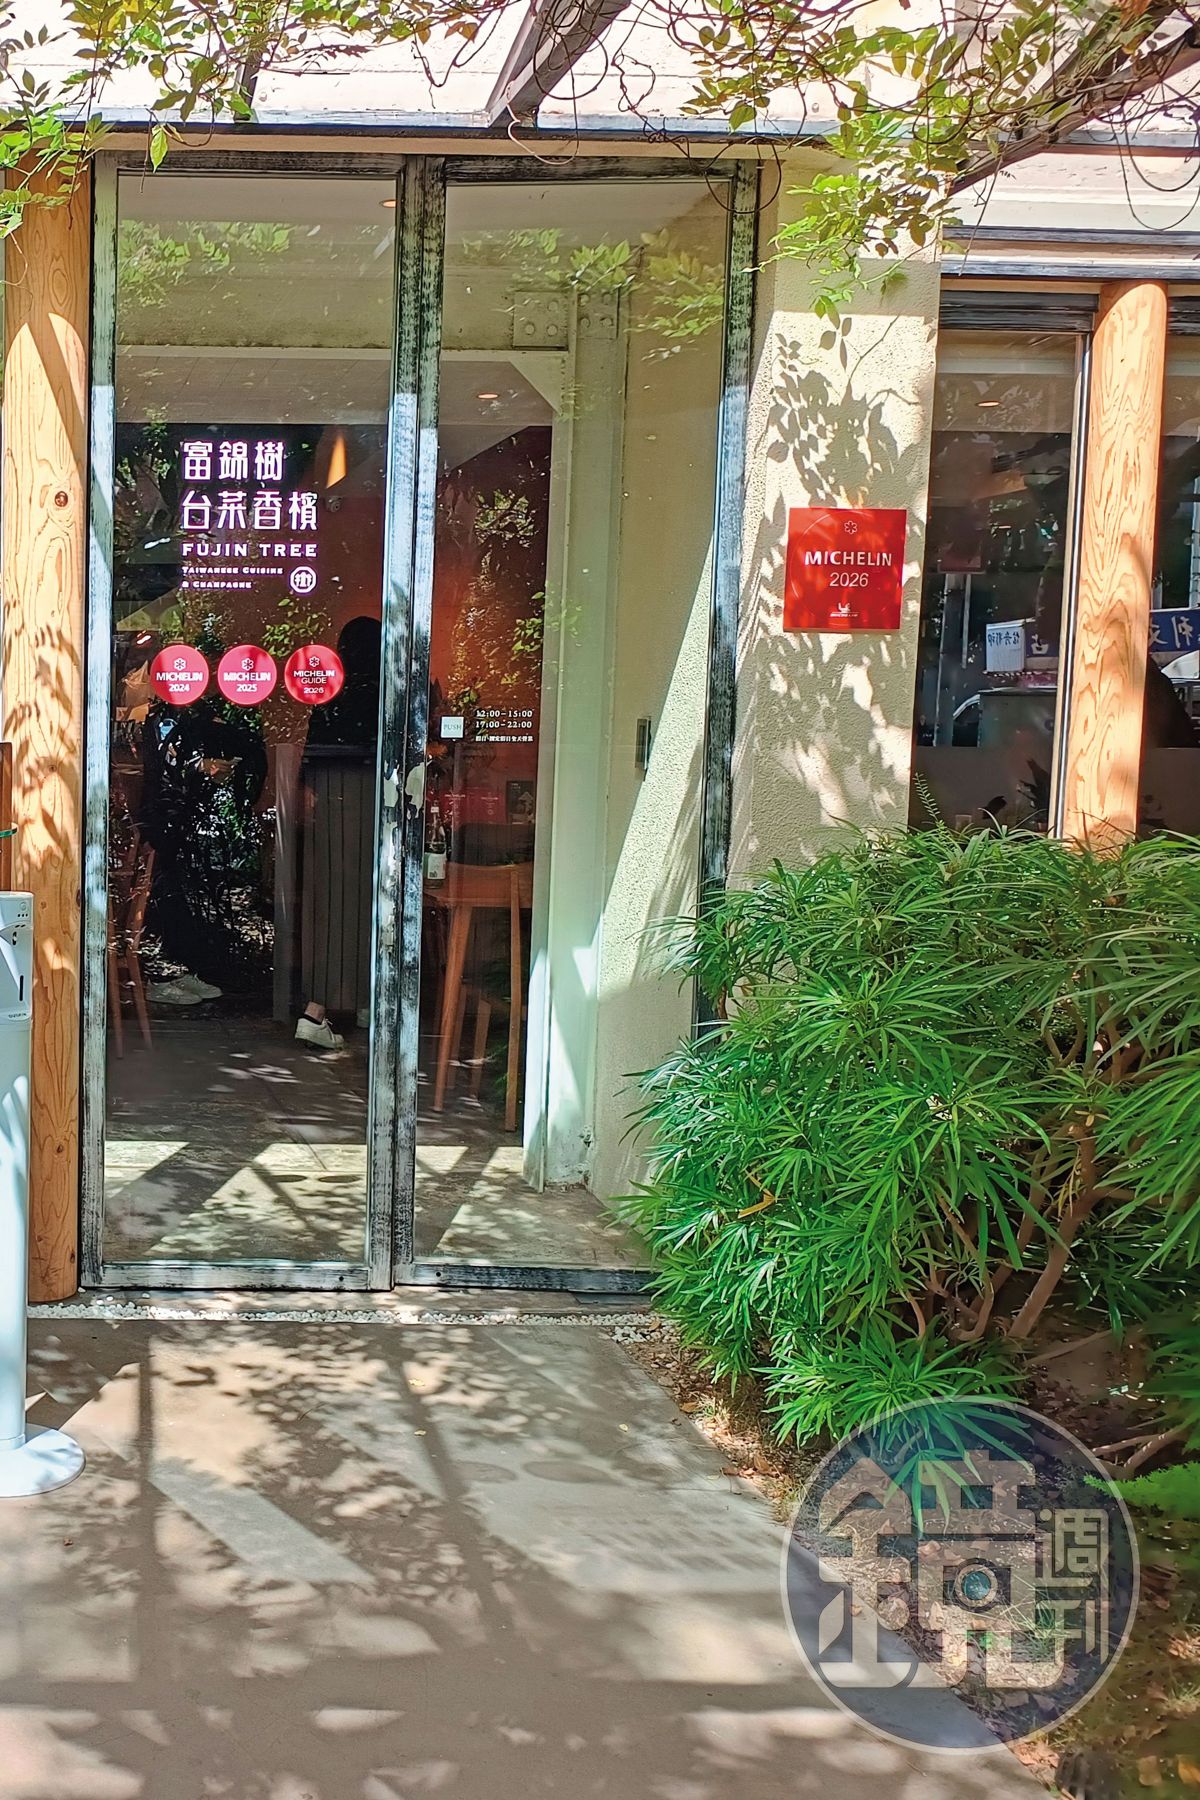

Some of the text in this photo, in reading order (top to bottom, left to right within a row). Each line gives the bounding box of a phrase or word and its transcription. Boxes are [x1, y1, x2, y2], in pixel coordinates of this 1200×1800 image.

[183, 441, 284, 480] 富錦樹
[182, 490, 318, 530] 台菜香檳
[182, 543, 317, 557] FUJIN TREE
[804, 551, 892, 566] MICHELIN
[829, 572, 869, 587] 2026
[156, 672, 203, 682] MICHELIN
[223, 672, 271, 682] MICHELIN
[293, 670, 336, 678] MICHELIN
[168, 683, 190, 692] 2024
[236, 683, 257, 692] 2025
[443, 723, 462, 731] PUSH
